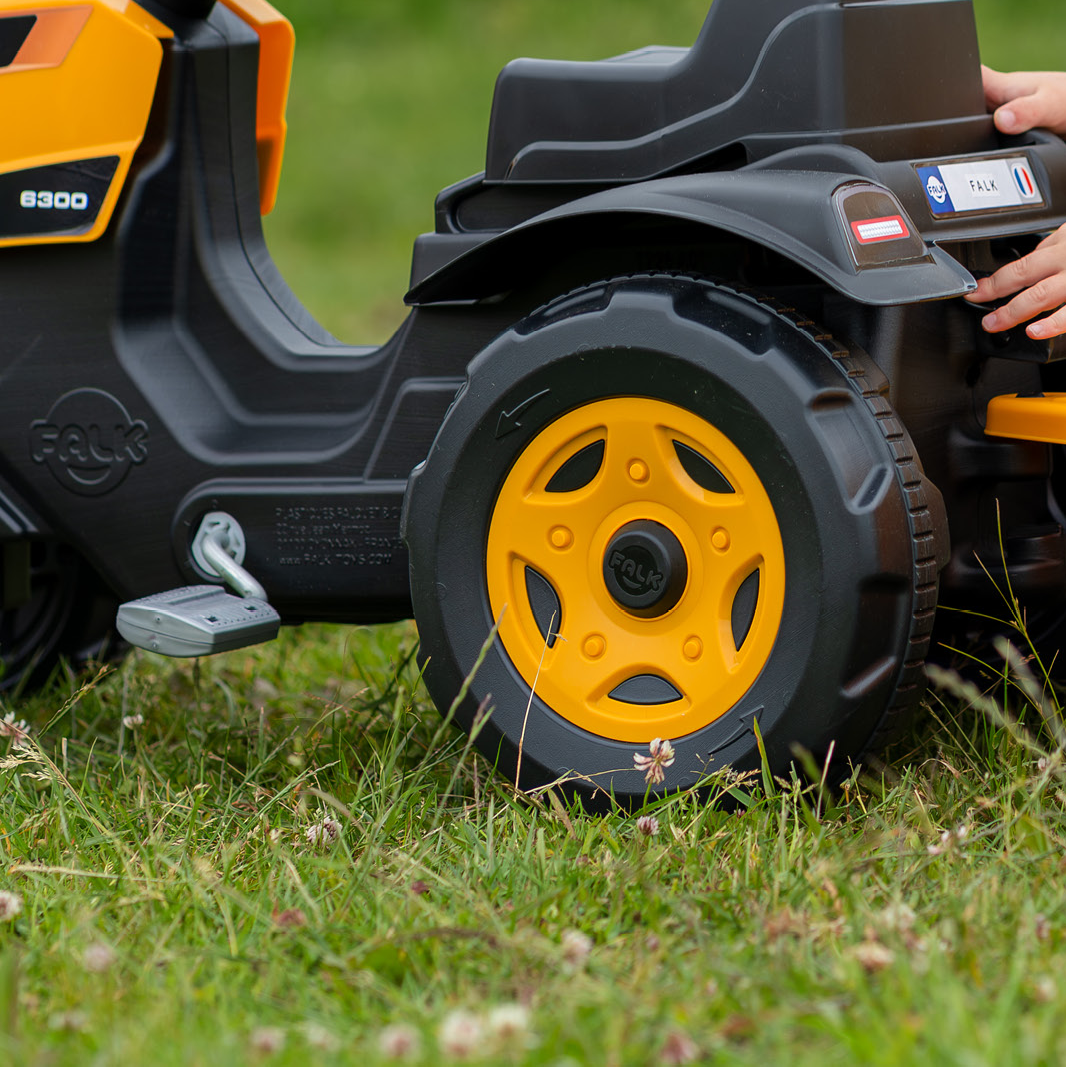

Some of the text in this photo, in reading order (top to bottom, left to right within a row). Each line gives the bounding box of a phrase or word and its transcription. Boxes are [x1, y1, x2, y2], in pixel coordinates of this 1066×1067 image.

[927, 183, 947, 195] FALK
[969, 179, 999, 193] FALK
[20, 190, 89, 210] 6300
[30, 419, 149, 465] FALK
[610, 551, 663, 591] FALK
